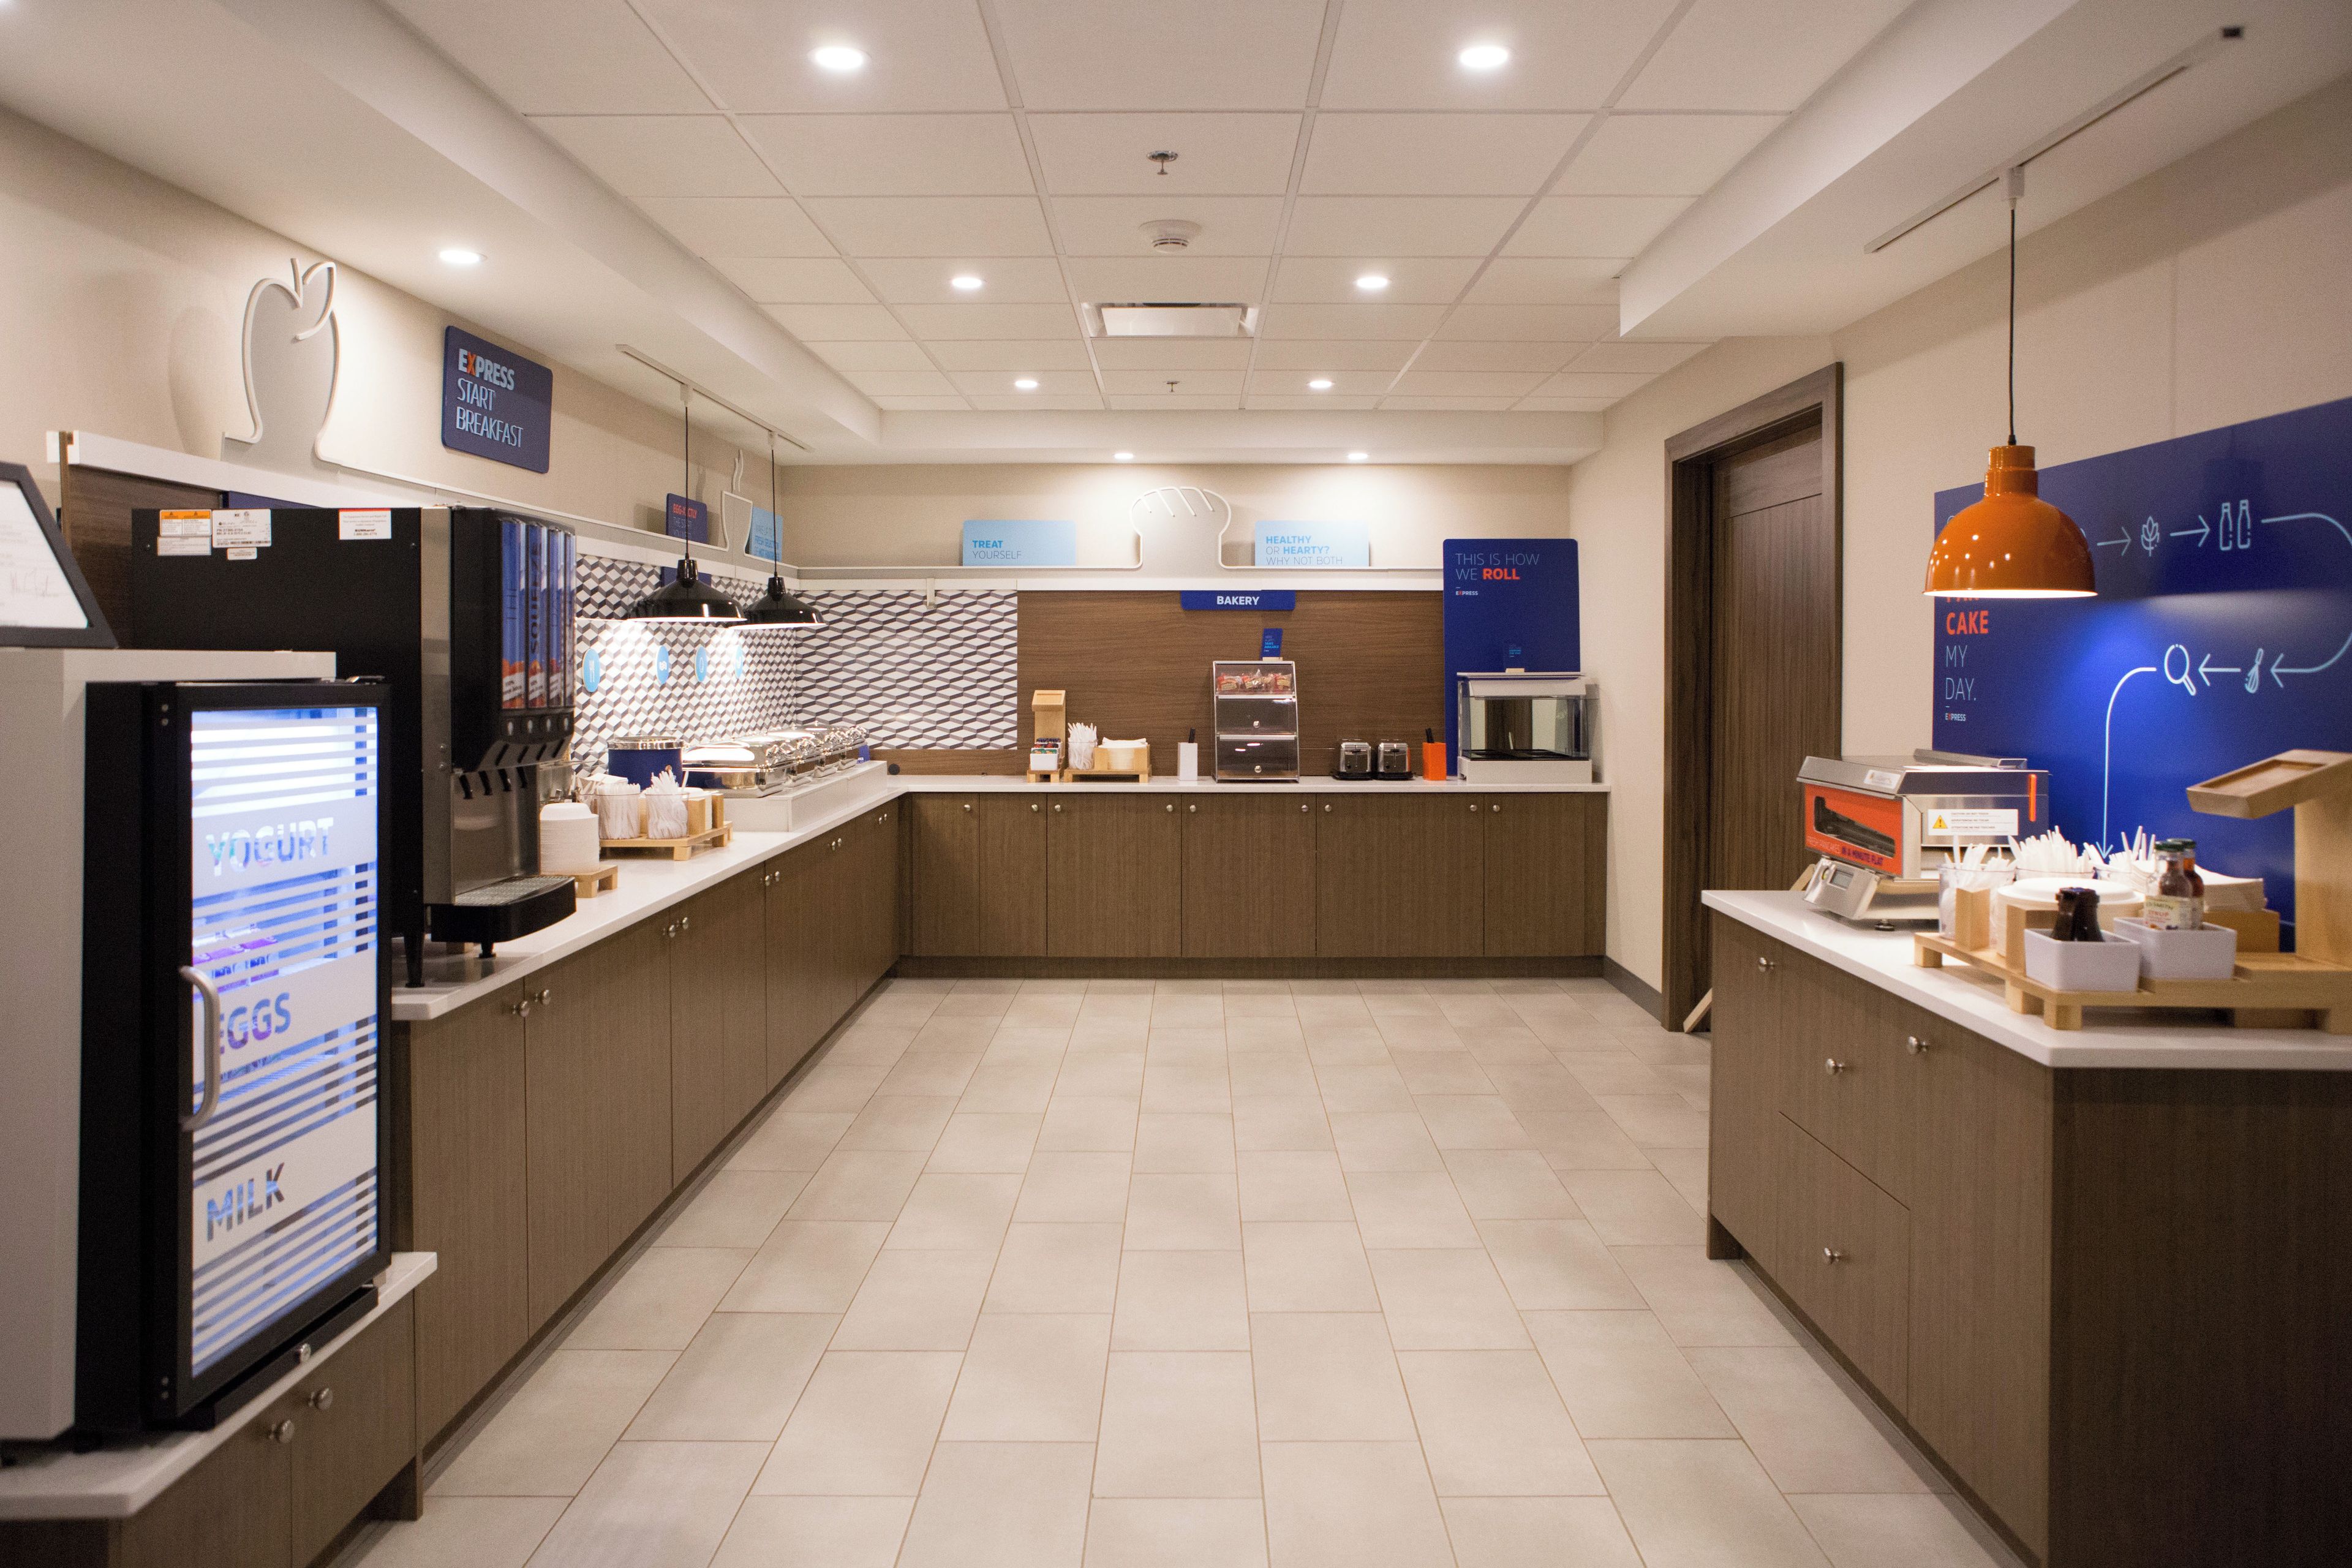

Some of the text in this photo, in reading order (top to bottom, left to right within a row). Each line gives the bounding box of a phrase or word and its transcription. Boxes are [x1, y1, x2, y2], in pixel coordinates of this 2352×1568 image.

[458, 348, 514, 390] EXPRESS
[458, 378, 495, 411] START
[456, 407, 524, 447] BREAKFAST
[972, 540, 1003, 548] TREAT
[1265, 535, 1312, 545] HEALTHY
[973, 550, 1022, 559] YOURSELF
[1265, 546, 1330, 555] OR HEARTY?
[1265, 556, 1343, 565] WHY NOT BOTH
[1455, 553, 1539, 565] THIS IS HOW
[1456, 568, 1520, 581] WE ROLL
[1216, 596, 1260, 605] BAKERY
[1946, 611, 1989, 635] CAKE
[1946, 645, 1967, 667] MY
[1945, 677, 1977, 701] DAY.
[1945, 713, 1966, 722] EXPRESS
[205, 816, 334, 878] YOGURT
[206, 1163, 285, 1242] MILK
